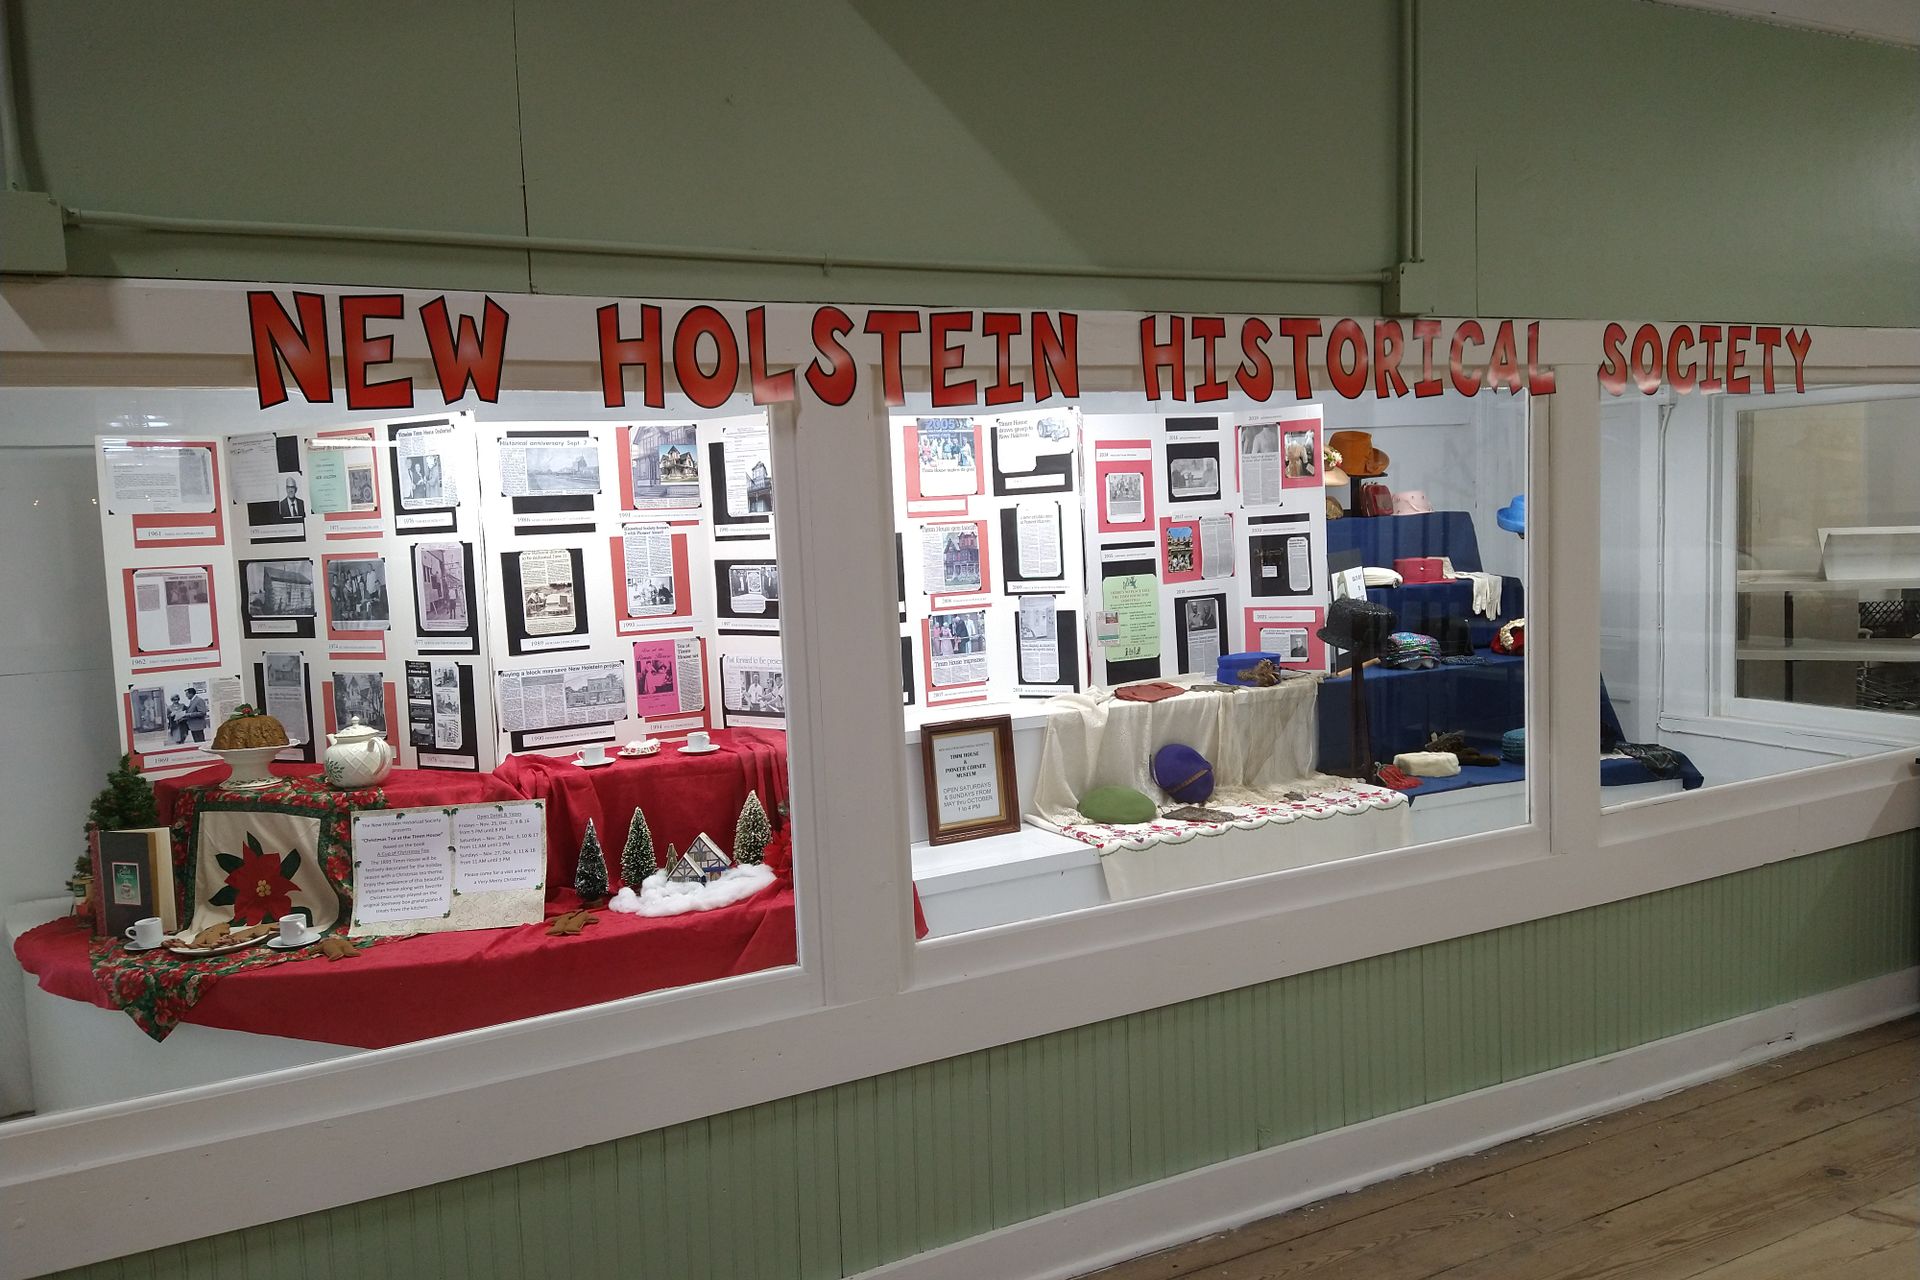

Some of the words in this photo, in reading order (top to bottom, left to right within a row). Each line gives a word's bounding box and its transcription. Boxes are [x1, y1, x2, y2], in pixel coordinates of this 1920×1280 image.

[247, 291, 509, 410] NEW
[596, 303, 1080, 409] HOLSTEIN
[1140, 314, 1557, 403] HISTORICAL
[1597, 321, 1812, 396] SOCIETY
[928, 419, 956, 429] 2005
[960, 782, 991, 791] SATURDAYS
[949, 791, 975, 800] SUNDAYS
[967, 795, 993, 804] OCTOBER
